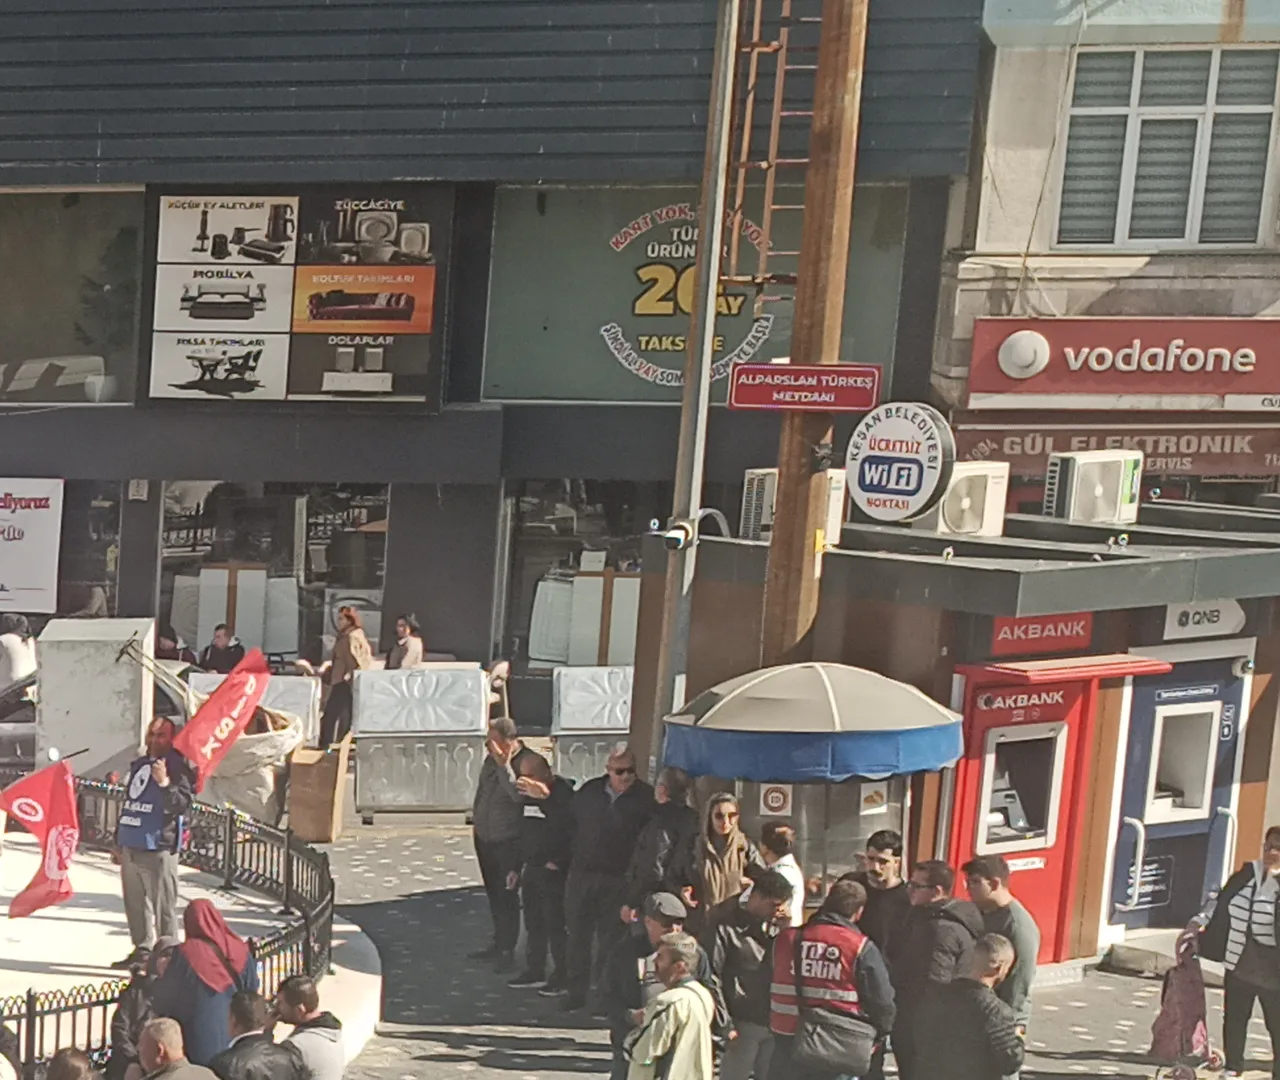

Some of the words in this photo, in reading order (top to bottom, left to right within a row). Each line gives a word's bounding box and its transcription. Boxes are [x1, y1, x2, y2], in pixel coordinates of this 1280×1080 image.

[610, 213, 653, 251] KART
[1063, 339, 1256, 373] vodafone
[739, 374, 817, 386] ALPARSLAN
[821, 372, 873, 389] TÜRKEŞ
[772, 391, 835, 402] MEYDANI
[868, 436, 922, 454] ÜCRETSİZ
[1003, 433, 1054, 455] GÜL
[867, 497, 910, 510] NOKTASI
[1192, 609, 1221, 626] QNB
[997, 620, 1086, 641] AKBANK
[993, 690, 1065, 709] AKBANK
